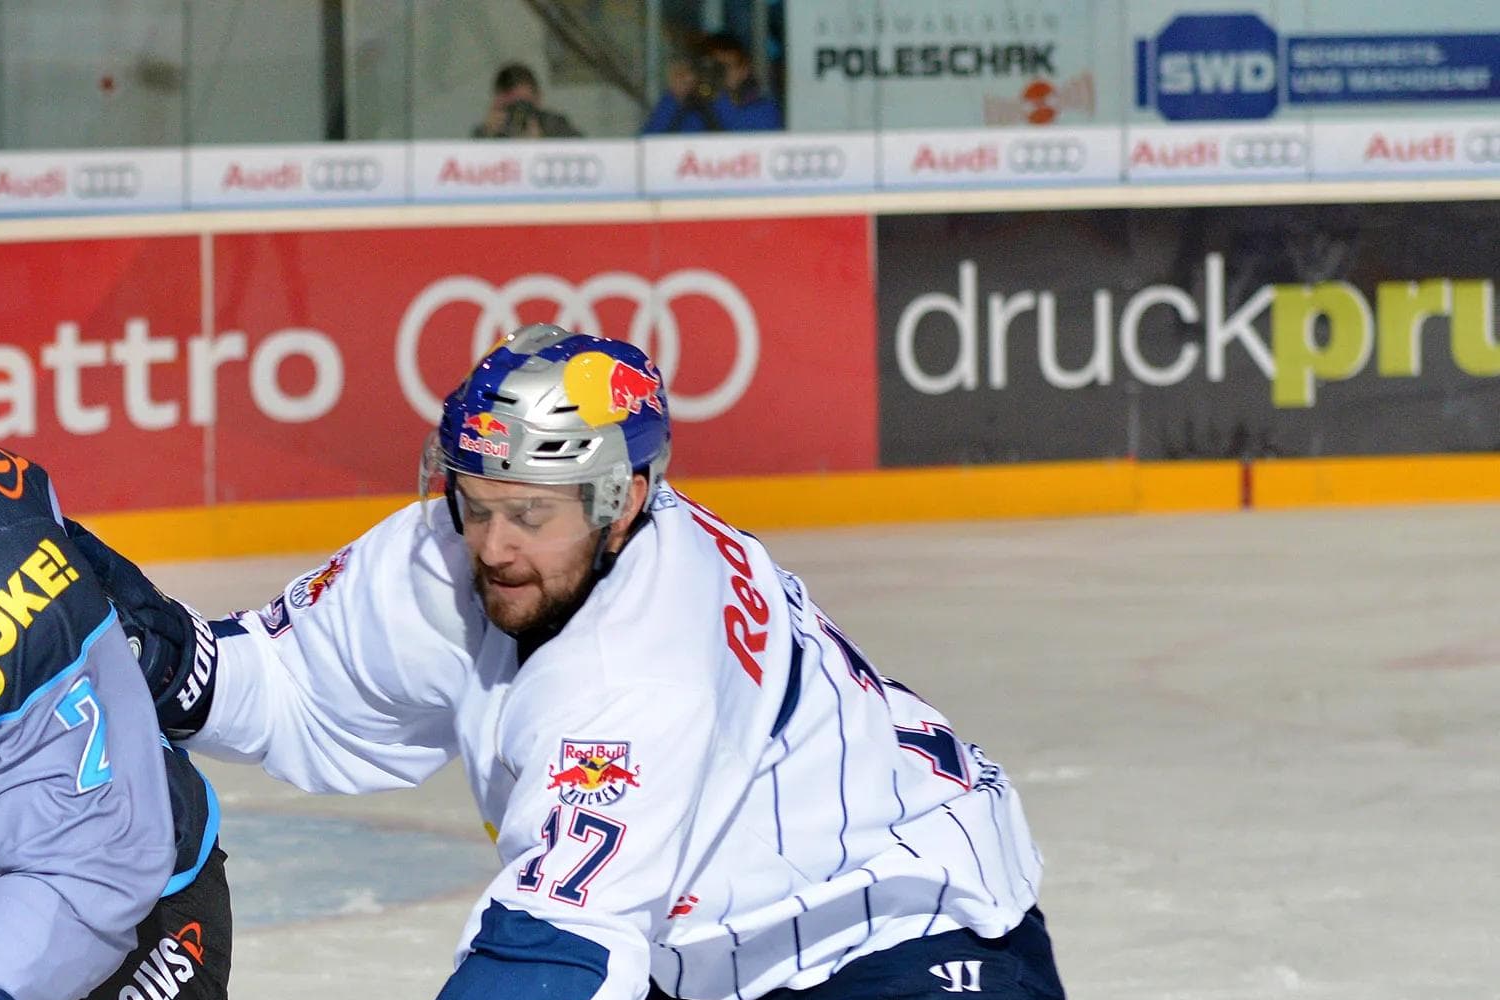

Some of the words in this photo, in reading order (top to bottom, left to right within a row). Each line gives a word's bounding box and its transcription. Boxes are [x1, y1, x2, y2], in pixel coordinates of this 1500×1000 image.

[813, 43, 1056, 80] POLESCHAK
[1159, 49, 1276, 94] SWD
[911, 144, 998, 175] Audi
[1129, 137, 1220, 170] Audi
[1364, 131, 1456, 164] Audi
[222, 162, 299, 193] Audi
[438, 156, 521, 187] Audi
[677, 148, 761, 180] Audi
[459, 432, 483, 452] Red
[482, 438, 510, 459] Bull
[689, 510, 770, 688] Red
[565, 744, 593, 760] Red
[596, 745, 626, 760] Bull
[517, 805, 627, 908] 17
